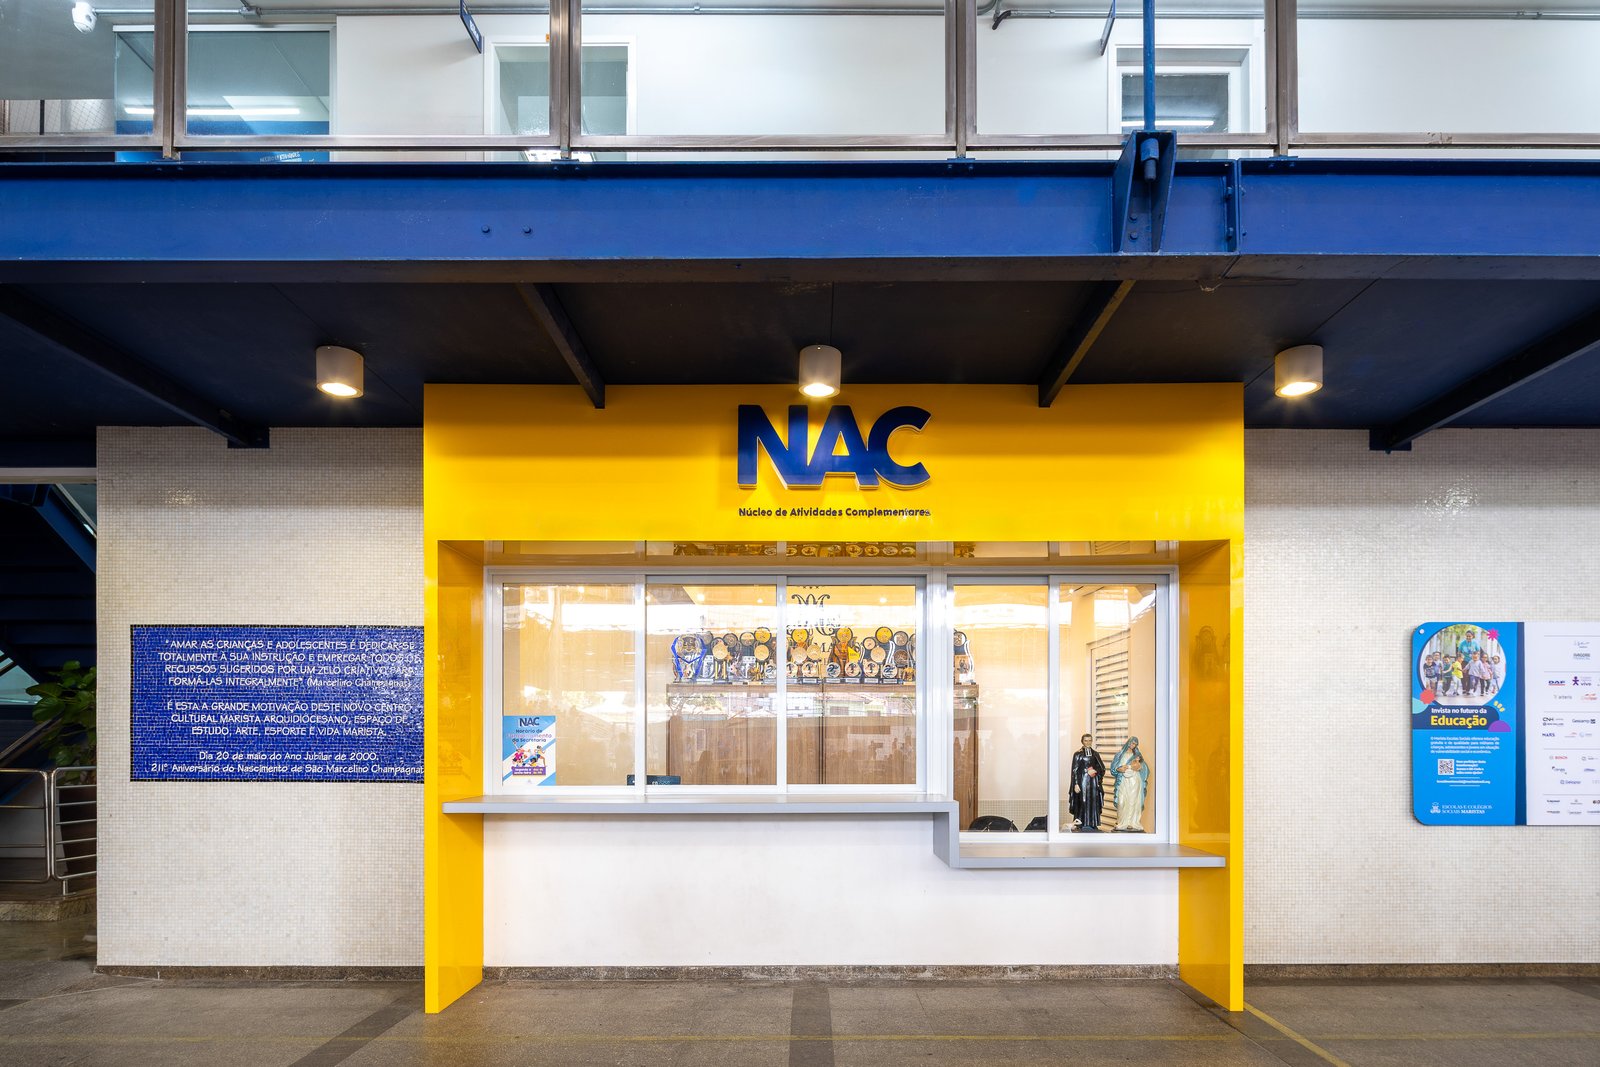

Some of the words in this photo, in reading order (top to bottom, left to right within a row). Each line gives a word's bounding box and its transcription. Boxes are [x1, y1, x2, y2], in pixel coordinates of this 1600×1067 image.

[737, 404, 932, 489] NAC
[739, 507, 773, 517] Núcleo
[775, 508, 787, 517] de
[790, 507, 843, 517] Atividades
[845, 507, 931, 519] Complementares
[200, 640, 214, 650] AS
[217, 640, 264, 652] CRIANÇAS
[267, 640, 272, 650] E
[276, 640, 347, 650] ADOLESCENTES
[359, 640, 415, 650] DEDICAR-SE
[158, 653, 218, 662] TOTALMENTE
[220, 651, 227, 662] À
[229, 653, 249, 662] SUA
[252, 651, 305, 665] INSTRUÇÃO
[309, 653, 314, 662] E
[317, 653, 367, 662] EMPREGAR
[369, 653, 404, 662] TODOS
[164, 665, 217, 674] RECURSOS
[219, 665, 274, 674] SUGERIDOS
[278, 665, 296, 674] POR
[300, 665, 315, 674] UM
[318, 665, 340, 674] ZELO
[343, 665, 388, 674] CRIATIVO
[168, 675, 222, 687] FORMÁ-LAS
[167, 700, 173, 711] É
[175, 703, 200, 711] ESTA
[201, 703, 208, 711] A
[211, 703, 248, 711] GRANDE
[251, 701, 308, 713] MOTIVAÇÃO
[311, 703, 340, 711] DESTE
[343, 703, 372, 711] NOVO
[374, 703, 412, 711] CENTRO
[171, 715, 218, 723] CULTURAL
[220, 715, 260, 723] MARISTA
[354, 715, 393, 726] ESPAÇO
[395, 715, 408, 723] DE
[519, 717, 540, 727] NAC
[1430, 715, 1487, 729] Educação
[191, 727, 232, 737] ESTUDO,
[235, 727, 261, 737] ARTE,
[264, 727, 306, 735] ESPORTE
[318, 727, 340, 735] VIDA
[199, 752, 213, 760] Dia
[216, 752, 229, 760] 20
[232, 752, 243, 760] de
[269, 752, 282, 760] do
[285, 752, 301, 760] Ano
[304, 752, 332, 760] Jubilar
[334, 752, 346, 760] de
[349, 752, 379, 760] 2000.
[171, 764, 220, 773] Aniversário
[222, 764, 234, 773] do
[237, 764, 288, 773] Nascimento
[290, 764, 303, 773] de
[305, 764, 323, 773] São
[326, 764, 369, 773] Marcelino
[371, 764, 424, 775] Champagnat
